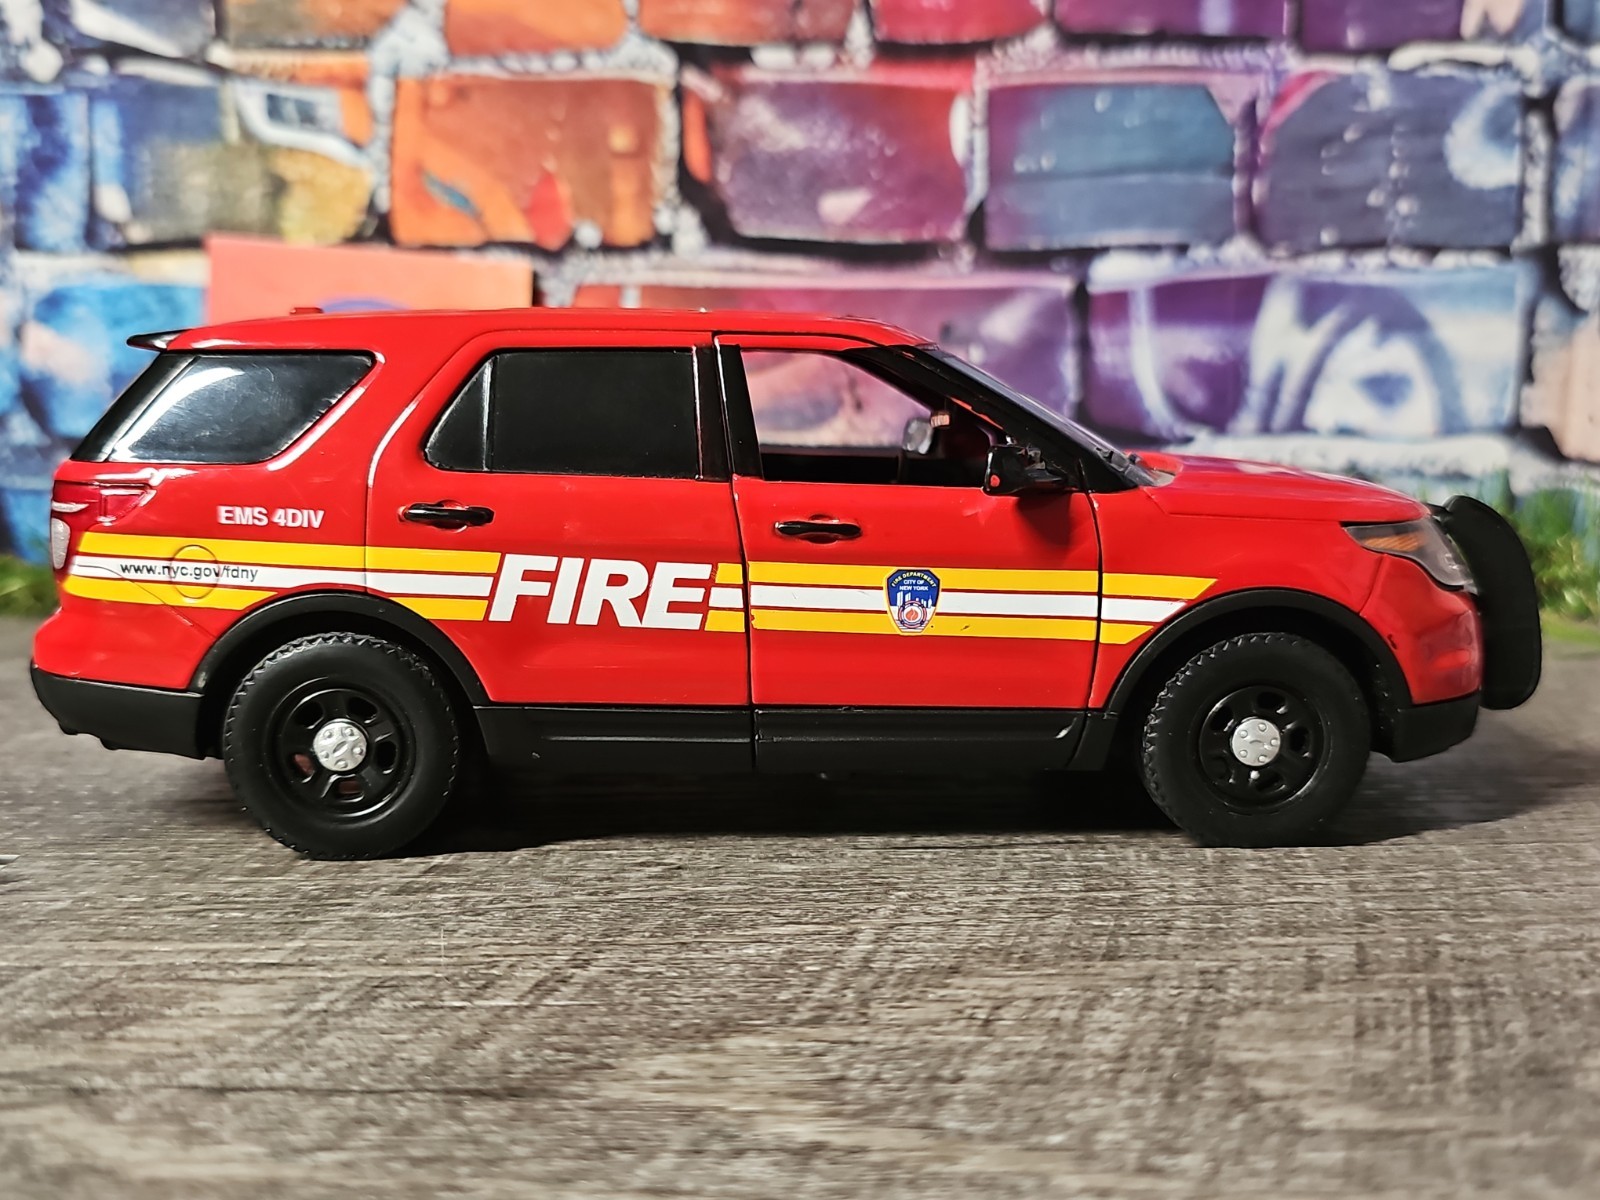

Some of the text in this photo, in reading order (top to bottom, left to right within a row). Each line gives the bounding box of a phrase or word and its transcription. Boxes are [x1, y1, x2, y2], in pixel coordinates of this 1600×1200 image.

[217, 505, 325, 529] EMS 4DIV
[120, 563, 258, 582] www.nyc.gov/fdny
[891, 571, 937, 587] FIRE DEPARTMENT
[488, 553, 713, 631] FIRE
